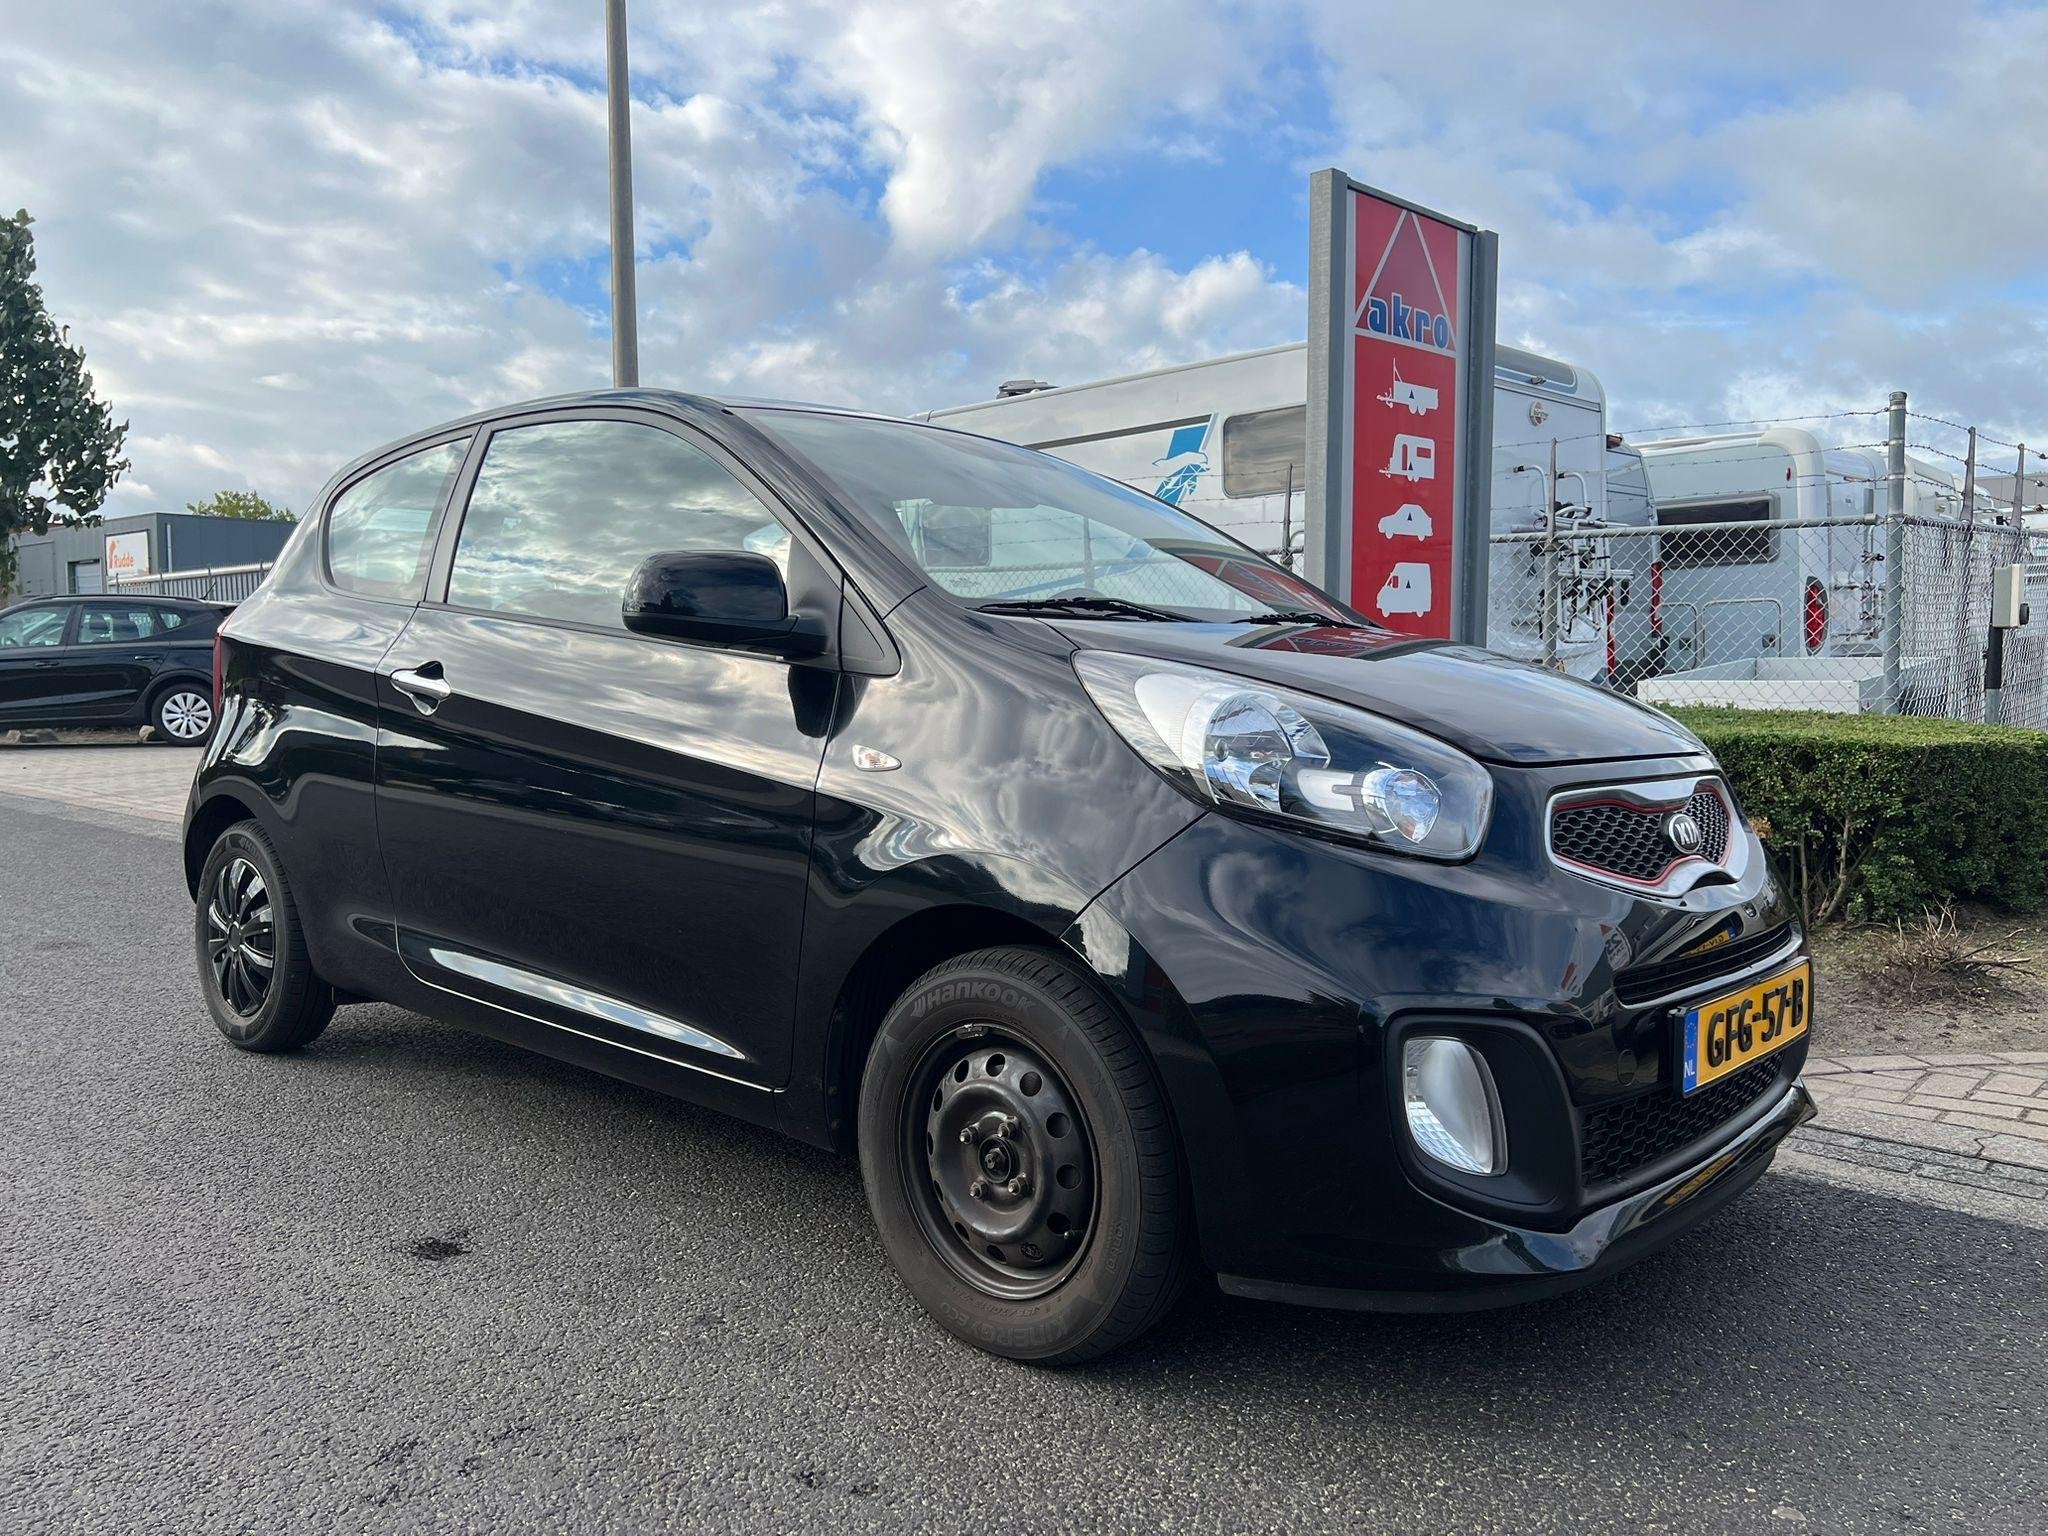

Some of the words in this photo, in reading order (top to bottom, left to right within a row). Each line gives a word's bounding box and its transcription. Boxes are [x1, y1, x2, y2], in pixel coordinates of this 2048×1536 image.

[1368, 293, 1449, 349] akro
[1708, 978, 1804, 1068] GFG-57-B
[1684, 1059, 1696, 1078] NL
